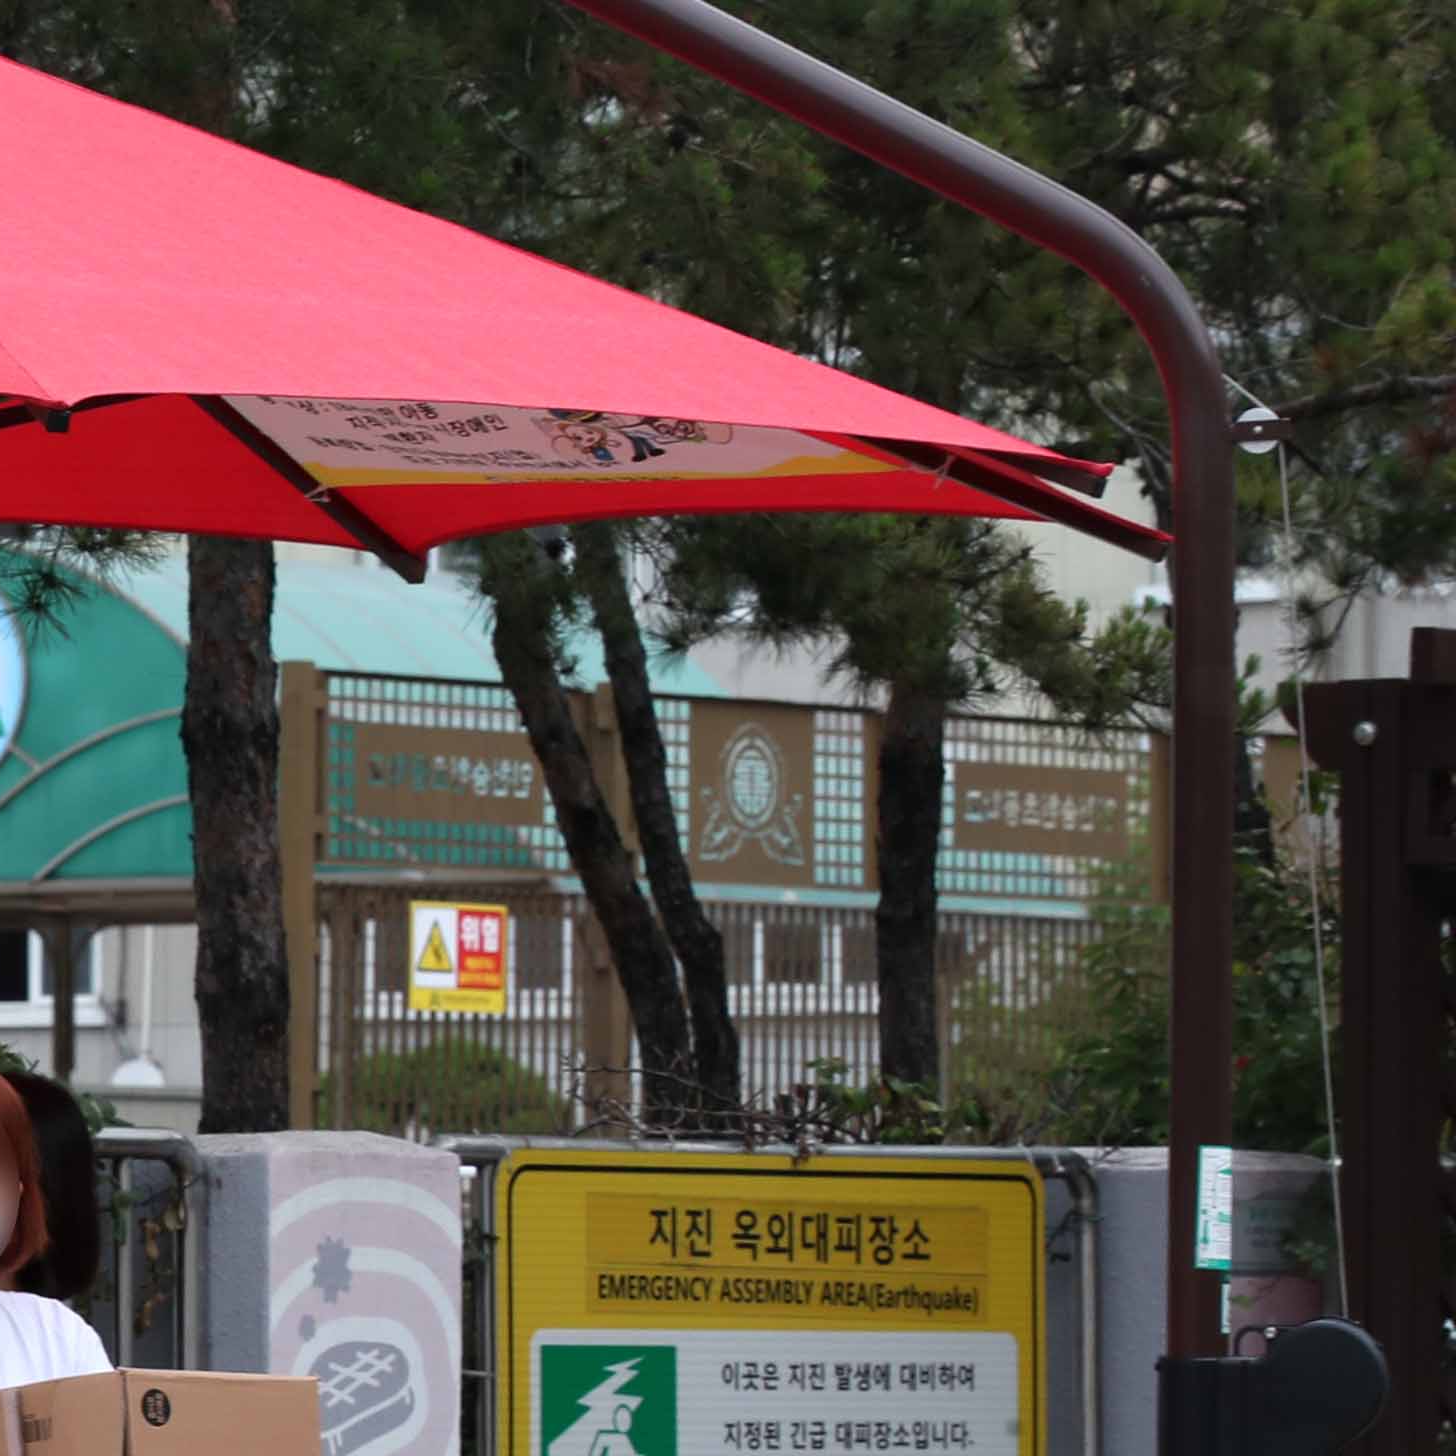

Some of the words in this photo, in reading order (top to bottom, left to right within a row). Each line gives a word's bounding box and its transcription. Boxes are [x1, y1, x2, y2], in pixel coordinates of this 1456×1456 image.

[649, 1206, 712, 1258] 지진
[731, 1210, 931, 1265] 옥외대피장소
[598, 1273, 713, 1301] EMERGENCY
[720, 1277, 814, 1304] ASSEMBLY
[721, 1362, 780, 1391] 이곳은
[788, 1363, 826, 1391] 지진
[835, 1363, 891, 1392] 발생에
[899, 1363, 975, 1392] 대비하여
[724, 1420, 781, 1450] 지정된
[790, 1421, 827, 1450] 긴급
[835, 1420, 975, 1451] 대피장소입니다.
